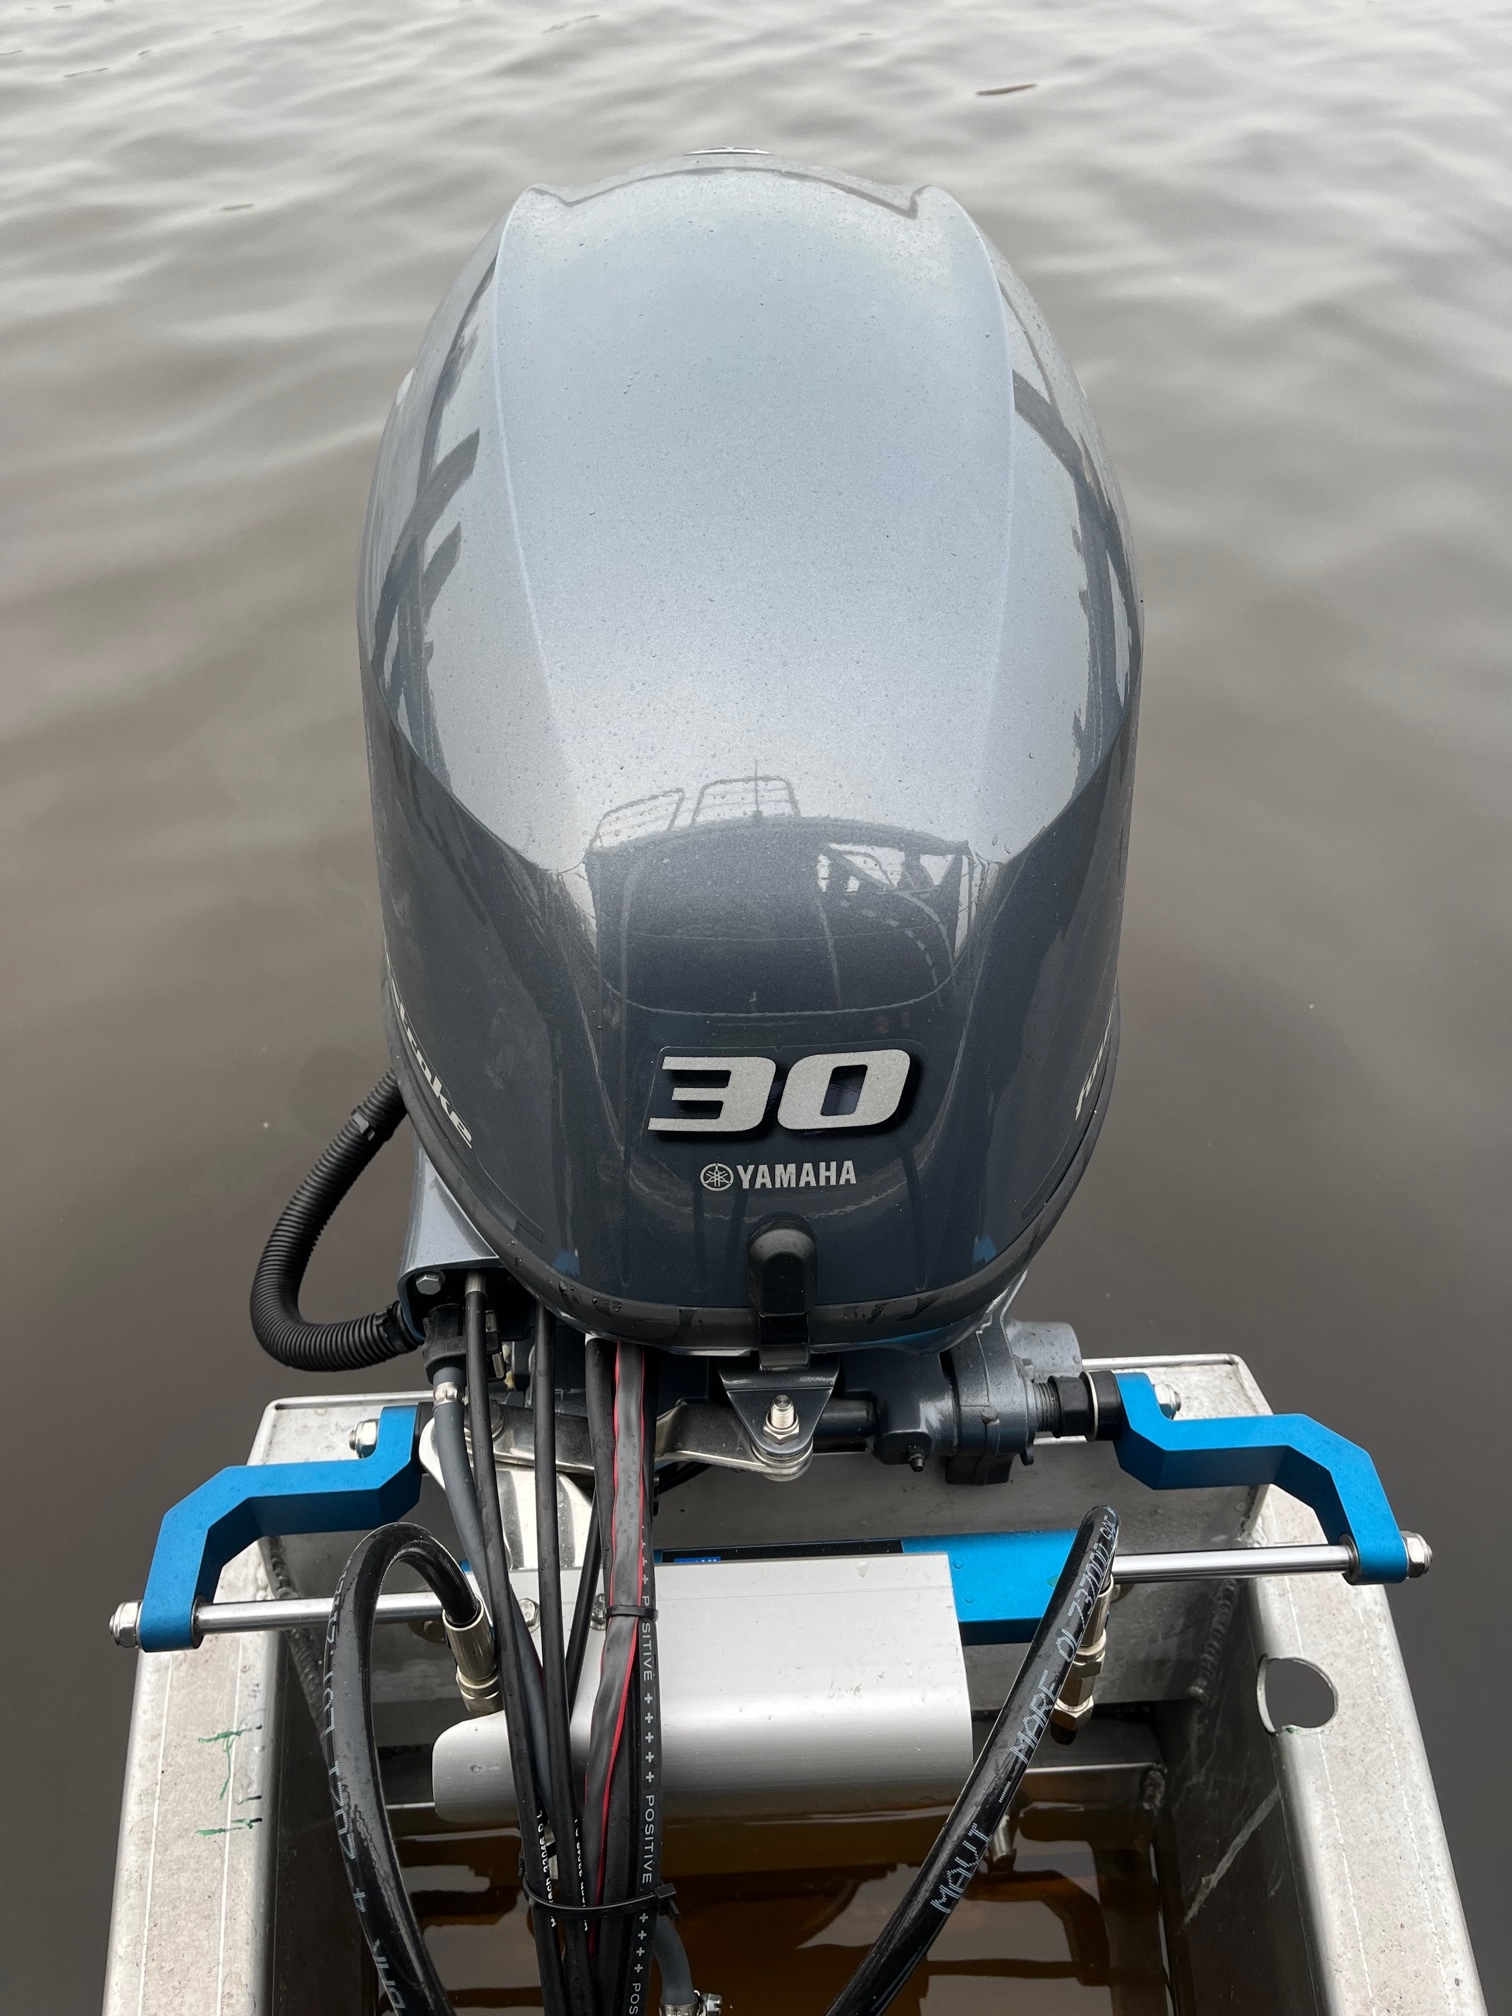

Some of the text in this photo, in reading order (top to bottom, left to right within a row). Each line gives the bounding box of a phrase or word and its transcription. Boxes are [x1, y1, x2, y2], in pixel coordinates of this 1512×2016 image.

[648, 1049, 910, 1132] 30
[736, 1160, 857, 1190] YAMAHA
[641, 1595, 653, 1682] PSITIVE
[1009, 1669, 1057, 1764] MARE
[642, 1794, 655, 1884] POSITIVE
